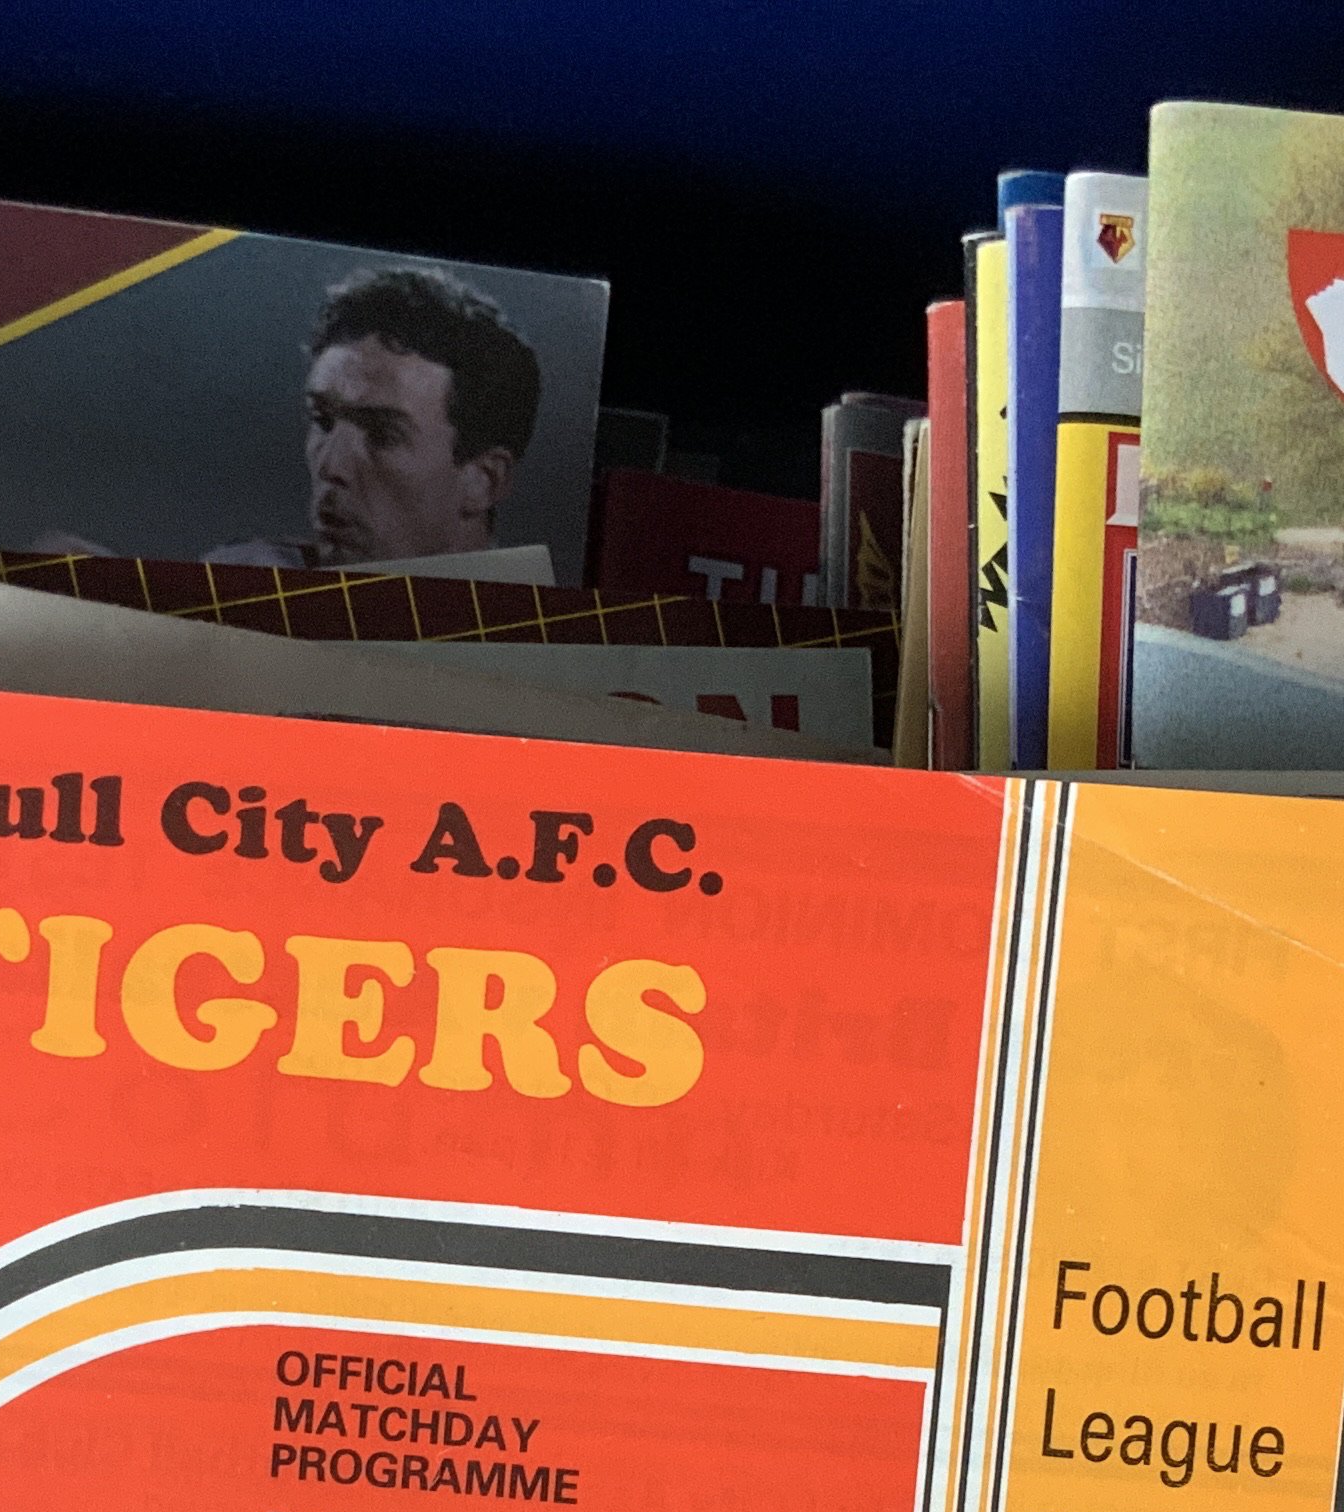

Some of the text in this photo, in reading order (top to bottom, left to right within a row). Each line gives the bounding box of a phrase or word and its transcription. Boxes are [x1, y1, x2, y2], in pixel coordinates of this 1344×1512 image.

[161, 781, 384, 884] City
[410, 802, 724, 896] A.F.C.
[1053, 1260, 1326, 1351] Football
[276, 1350, 477, 1402] OFFICIAL
[273, 1397, 541, 1453] MATCHDAY
[1041, 1388, 1285, 1488] League
[270, 1443, 580, 1505] PROGRAMME
